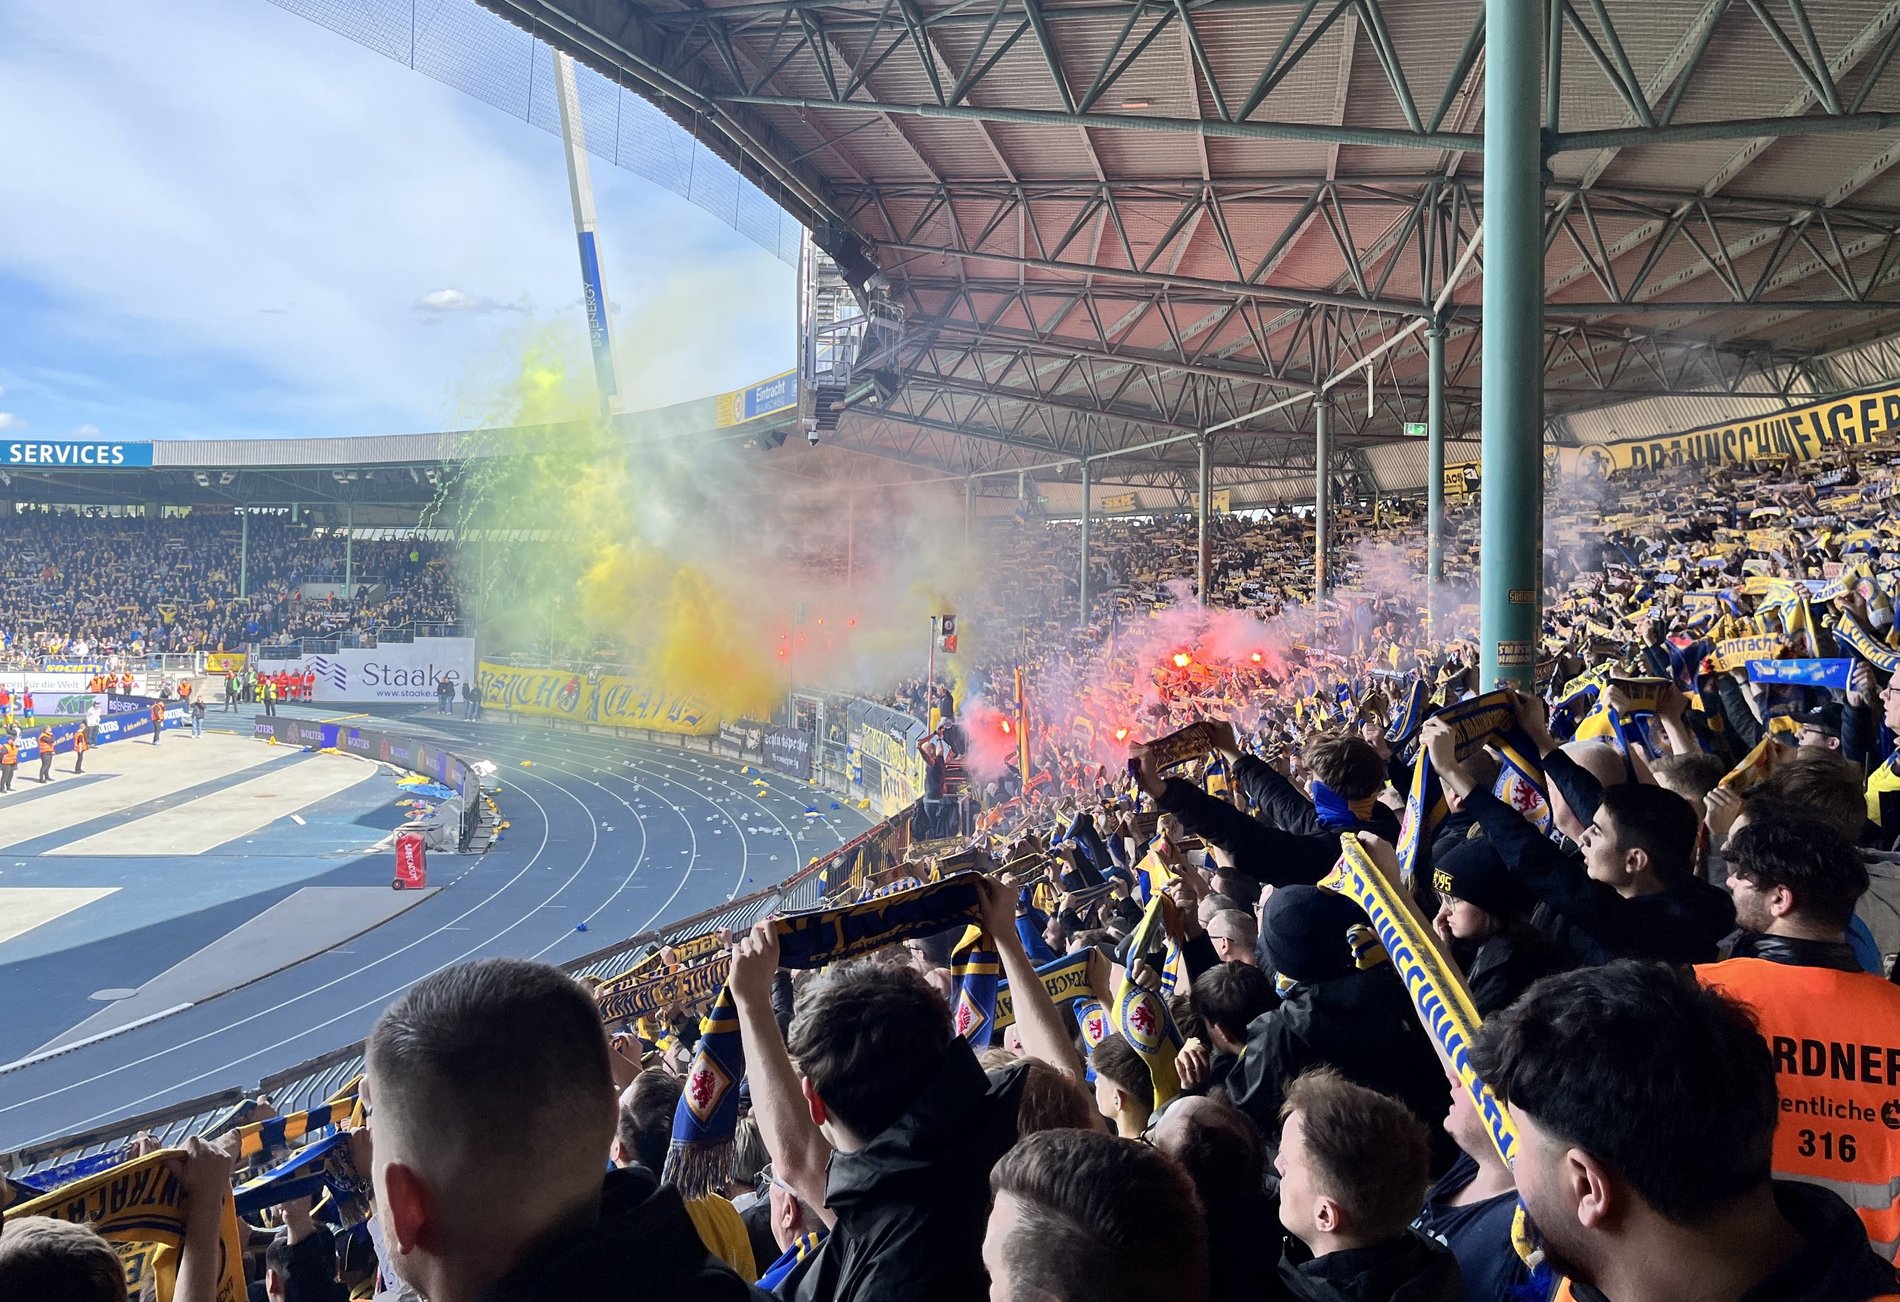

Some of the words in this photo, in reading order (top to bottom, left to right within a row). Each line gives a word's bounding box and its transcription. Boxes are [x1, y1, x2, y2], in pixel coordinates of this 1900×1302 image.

[756, 380, 785, 402] Eintracht
[9, 443, 125, 464] SERVICES
[1716, 636, 1773, 659] Eintrach
[46, 664, 102, 673] SOCIETY
[362, 662, 460, 687] Staake
[41, 680, 55, 689] die
[57, 680, 79, 689] Welt
[98, 721, 119, 734] OLTERS
[254, 724, 274, 734] OLTERS
[300, 729, 325, 742] WOLTERS
[347, 736, 370, 749] WOLTERS
[1773, 1036, 1900, 1086] RDNER
[1781, 1096, 1876, 1122] entliche
[1798, 1129, 1856, 1163] 316
